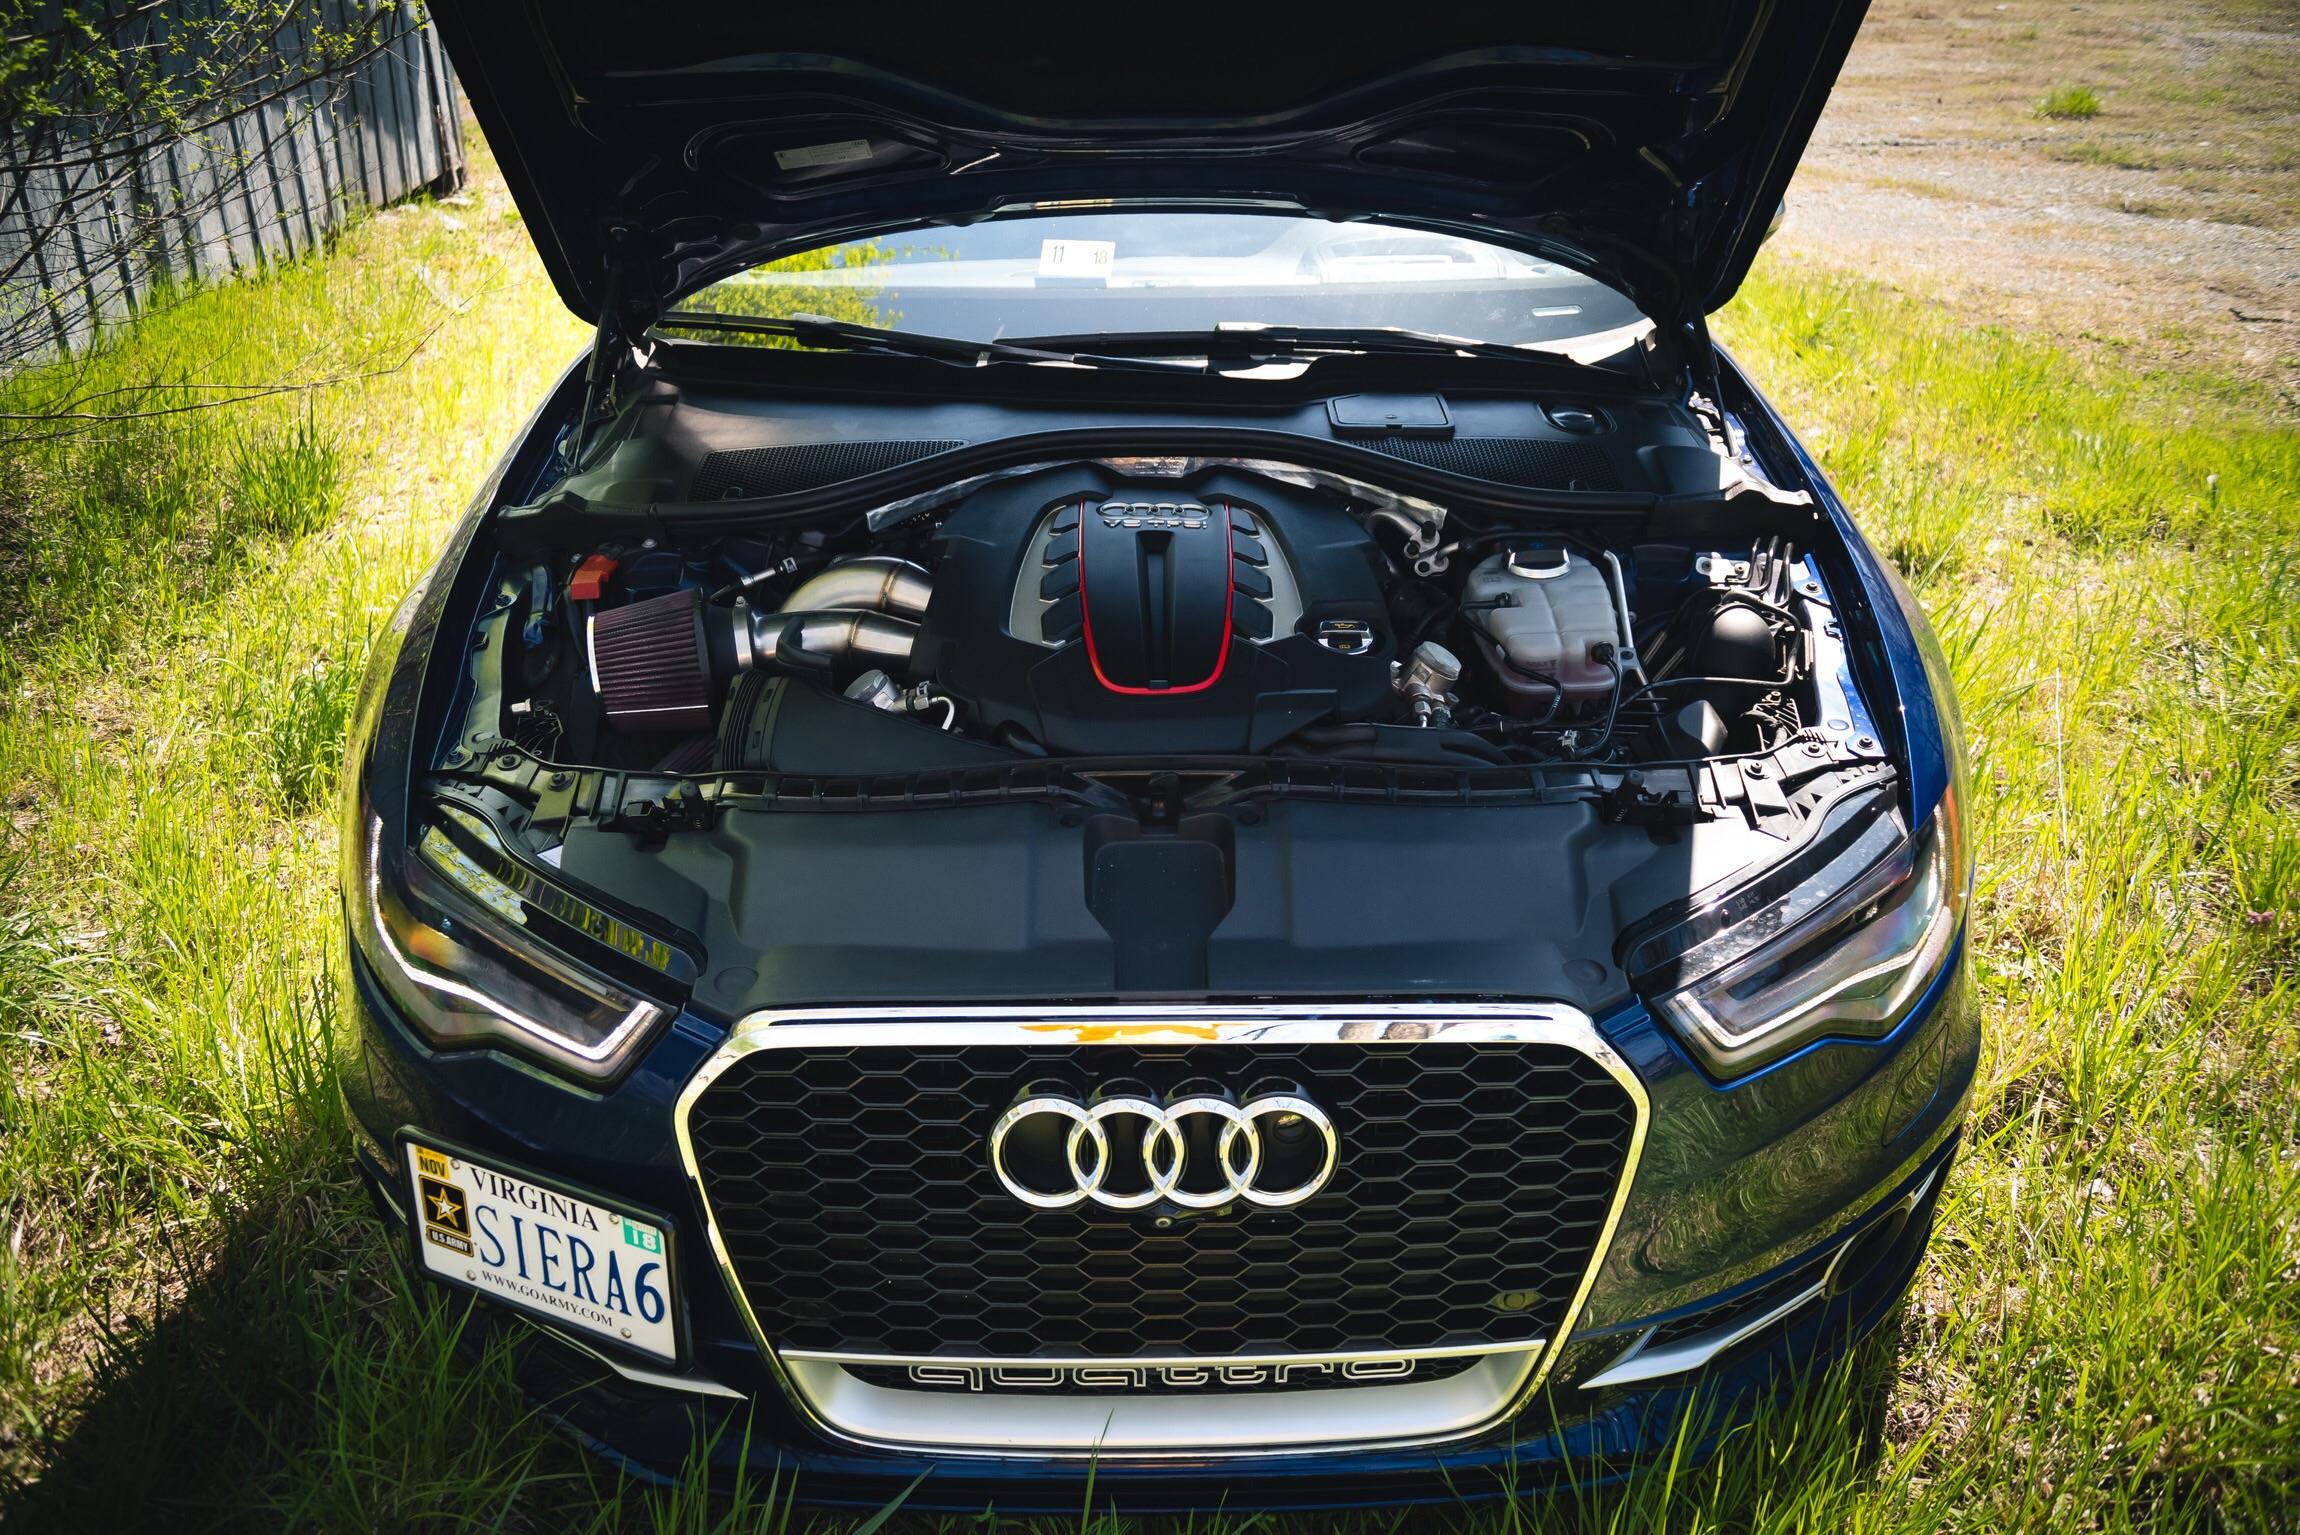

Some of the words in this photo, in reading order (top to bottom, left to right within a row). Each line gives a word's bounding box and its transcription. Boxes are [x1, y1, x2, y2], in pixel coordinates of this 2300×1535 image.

[1052, 245, 1065, 263] 11
[419, 1155, 446, 1178] NOV
[471, 1168, 600, 1232] VIRGINIA
[632, 1230, 658, 1251] 18
[475, 1205, 666, 1324] SIERA6
[482, 1270, 613, 1328] WWW.GOARMY.COM
[908, 1361, 1415, 1391] quattro
